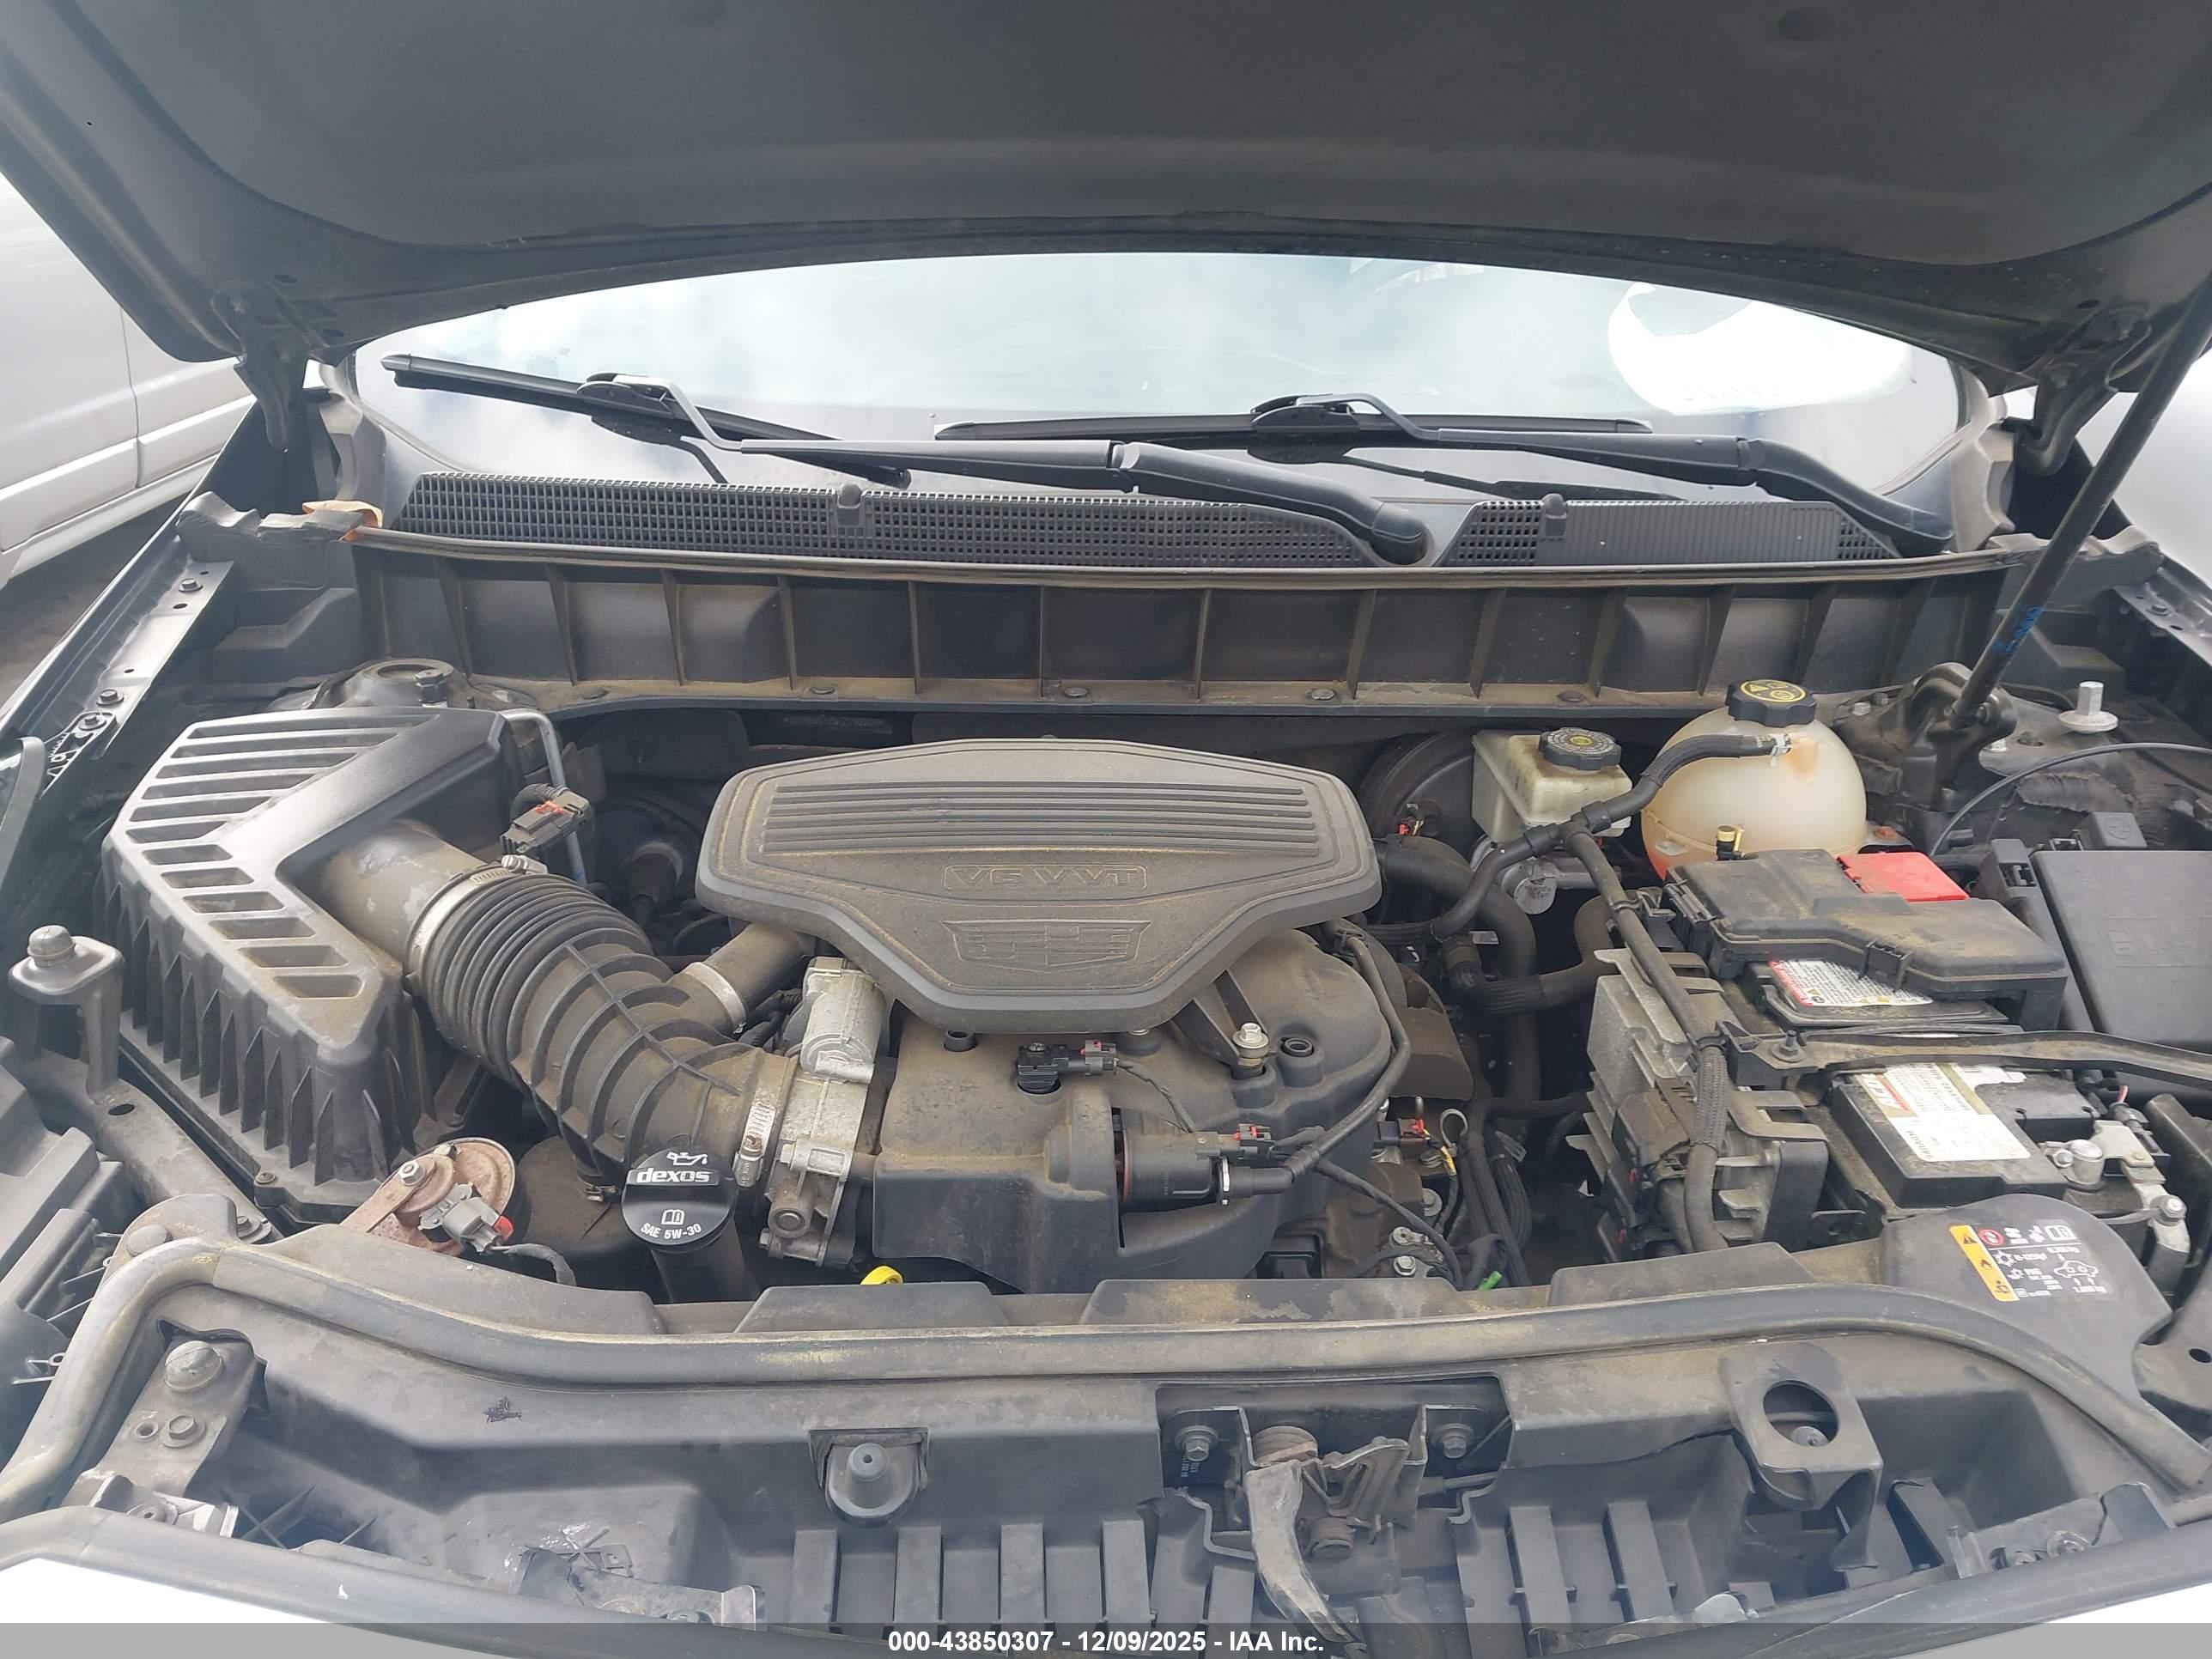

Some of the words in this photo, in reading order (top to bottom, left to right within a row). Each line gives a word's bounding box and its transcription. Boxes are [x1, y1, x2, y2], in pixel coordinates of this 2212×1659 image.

[951, 867, 1024, 886] V6
[1033, 867, 1139, 886] VVT
[636, 1168, 712, 1183] dexos
[641, 1223, 662, 1238] SAE
[664, 1224, 702, 1240] 5W-30
